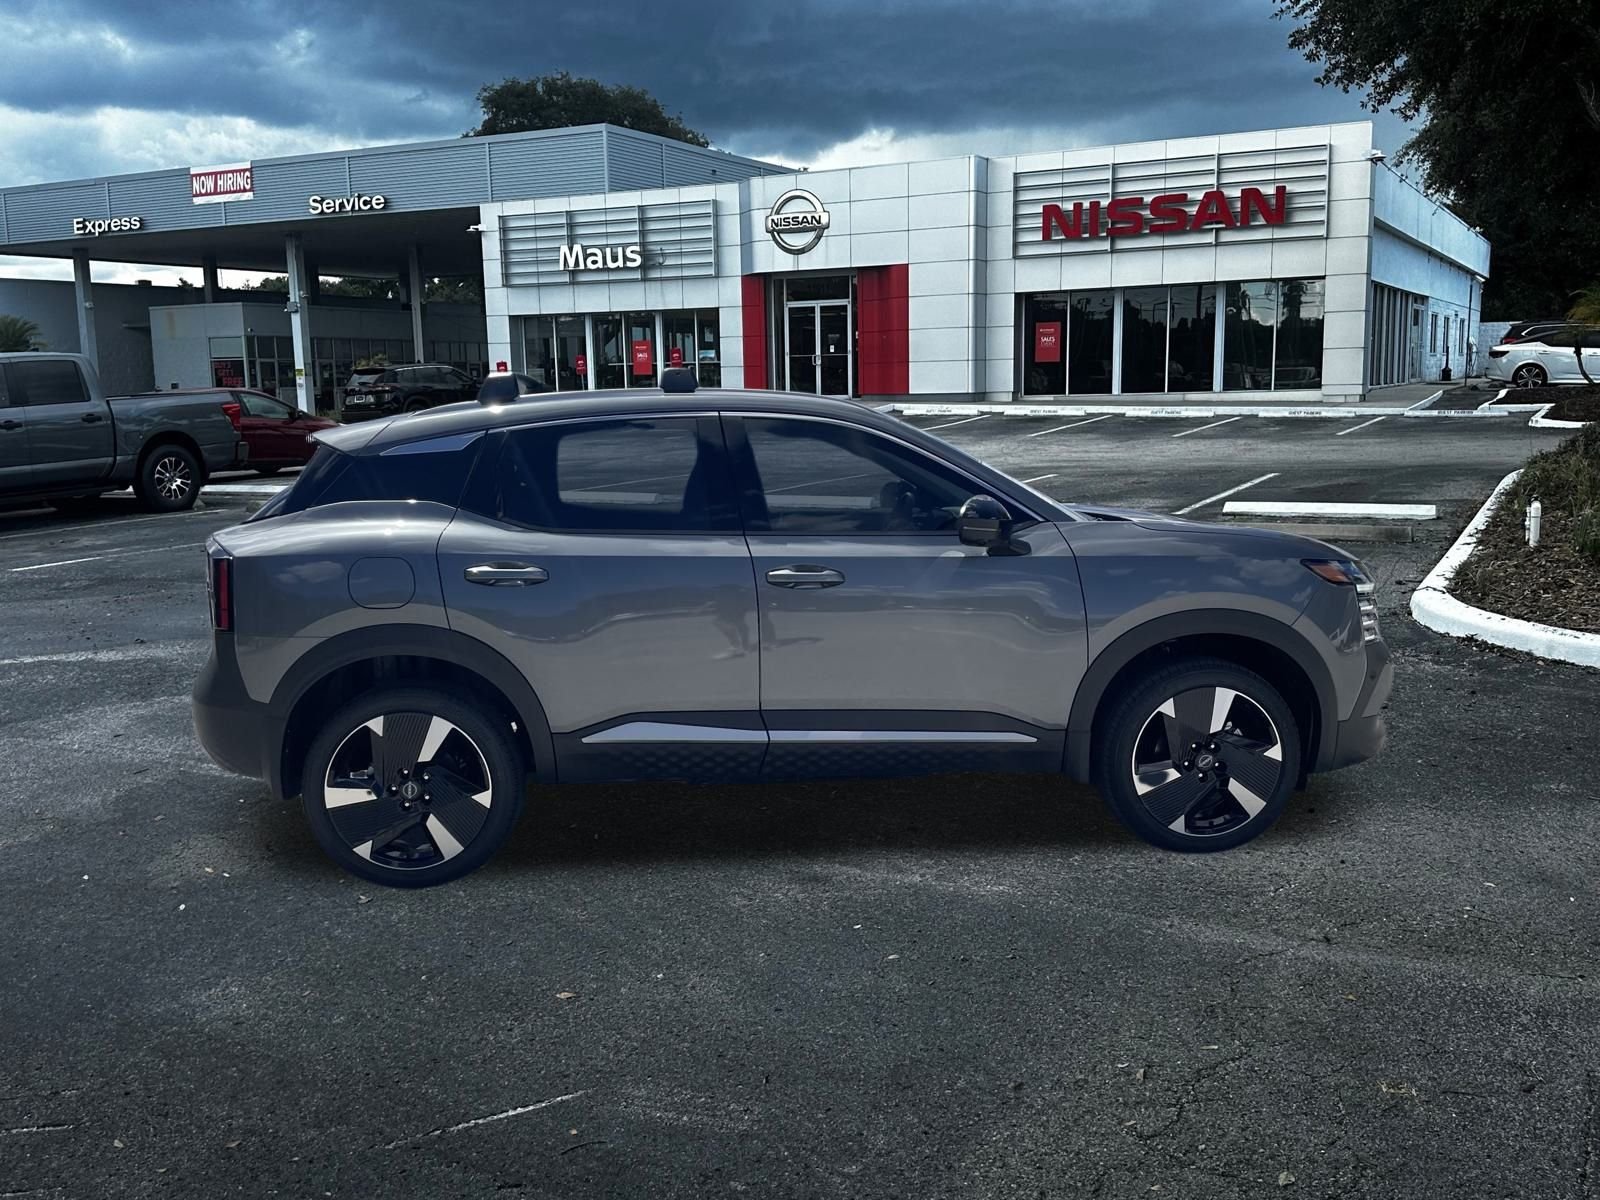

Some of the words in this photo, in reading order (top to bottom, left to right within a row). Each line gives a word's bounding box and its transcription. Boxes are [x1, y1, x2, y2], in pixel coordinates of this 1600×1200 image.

[193, 174, 215, 194] NOW
[217, 171, 251, 192] HIRING
[308, 193, 385, 215] Service
[1042, 185, 1287, 241] NISSAN
[73, 216, 141, 236] Express
[770, 214, 823, 229] NISSAN
[559, 244, 642, 271] Maus
